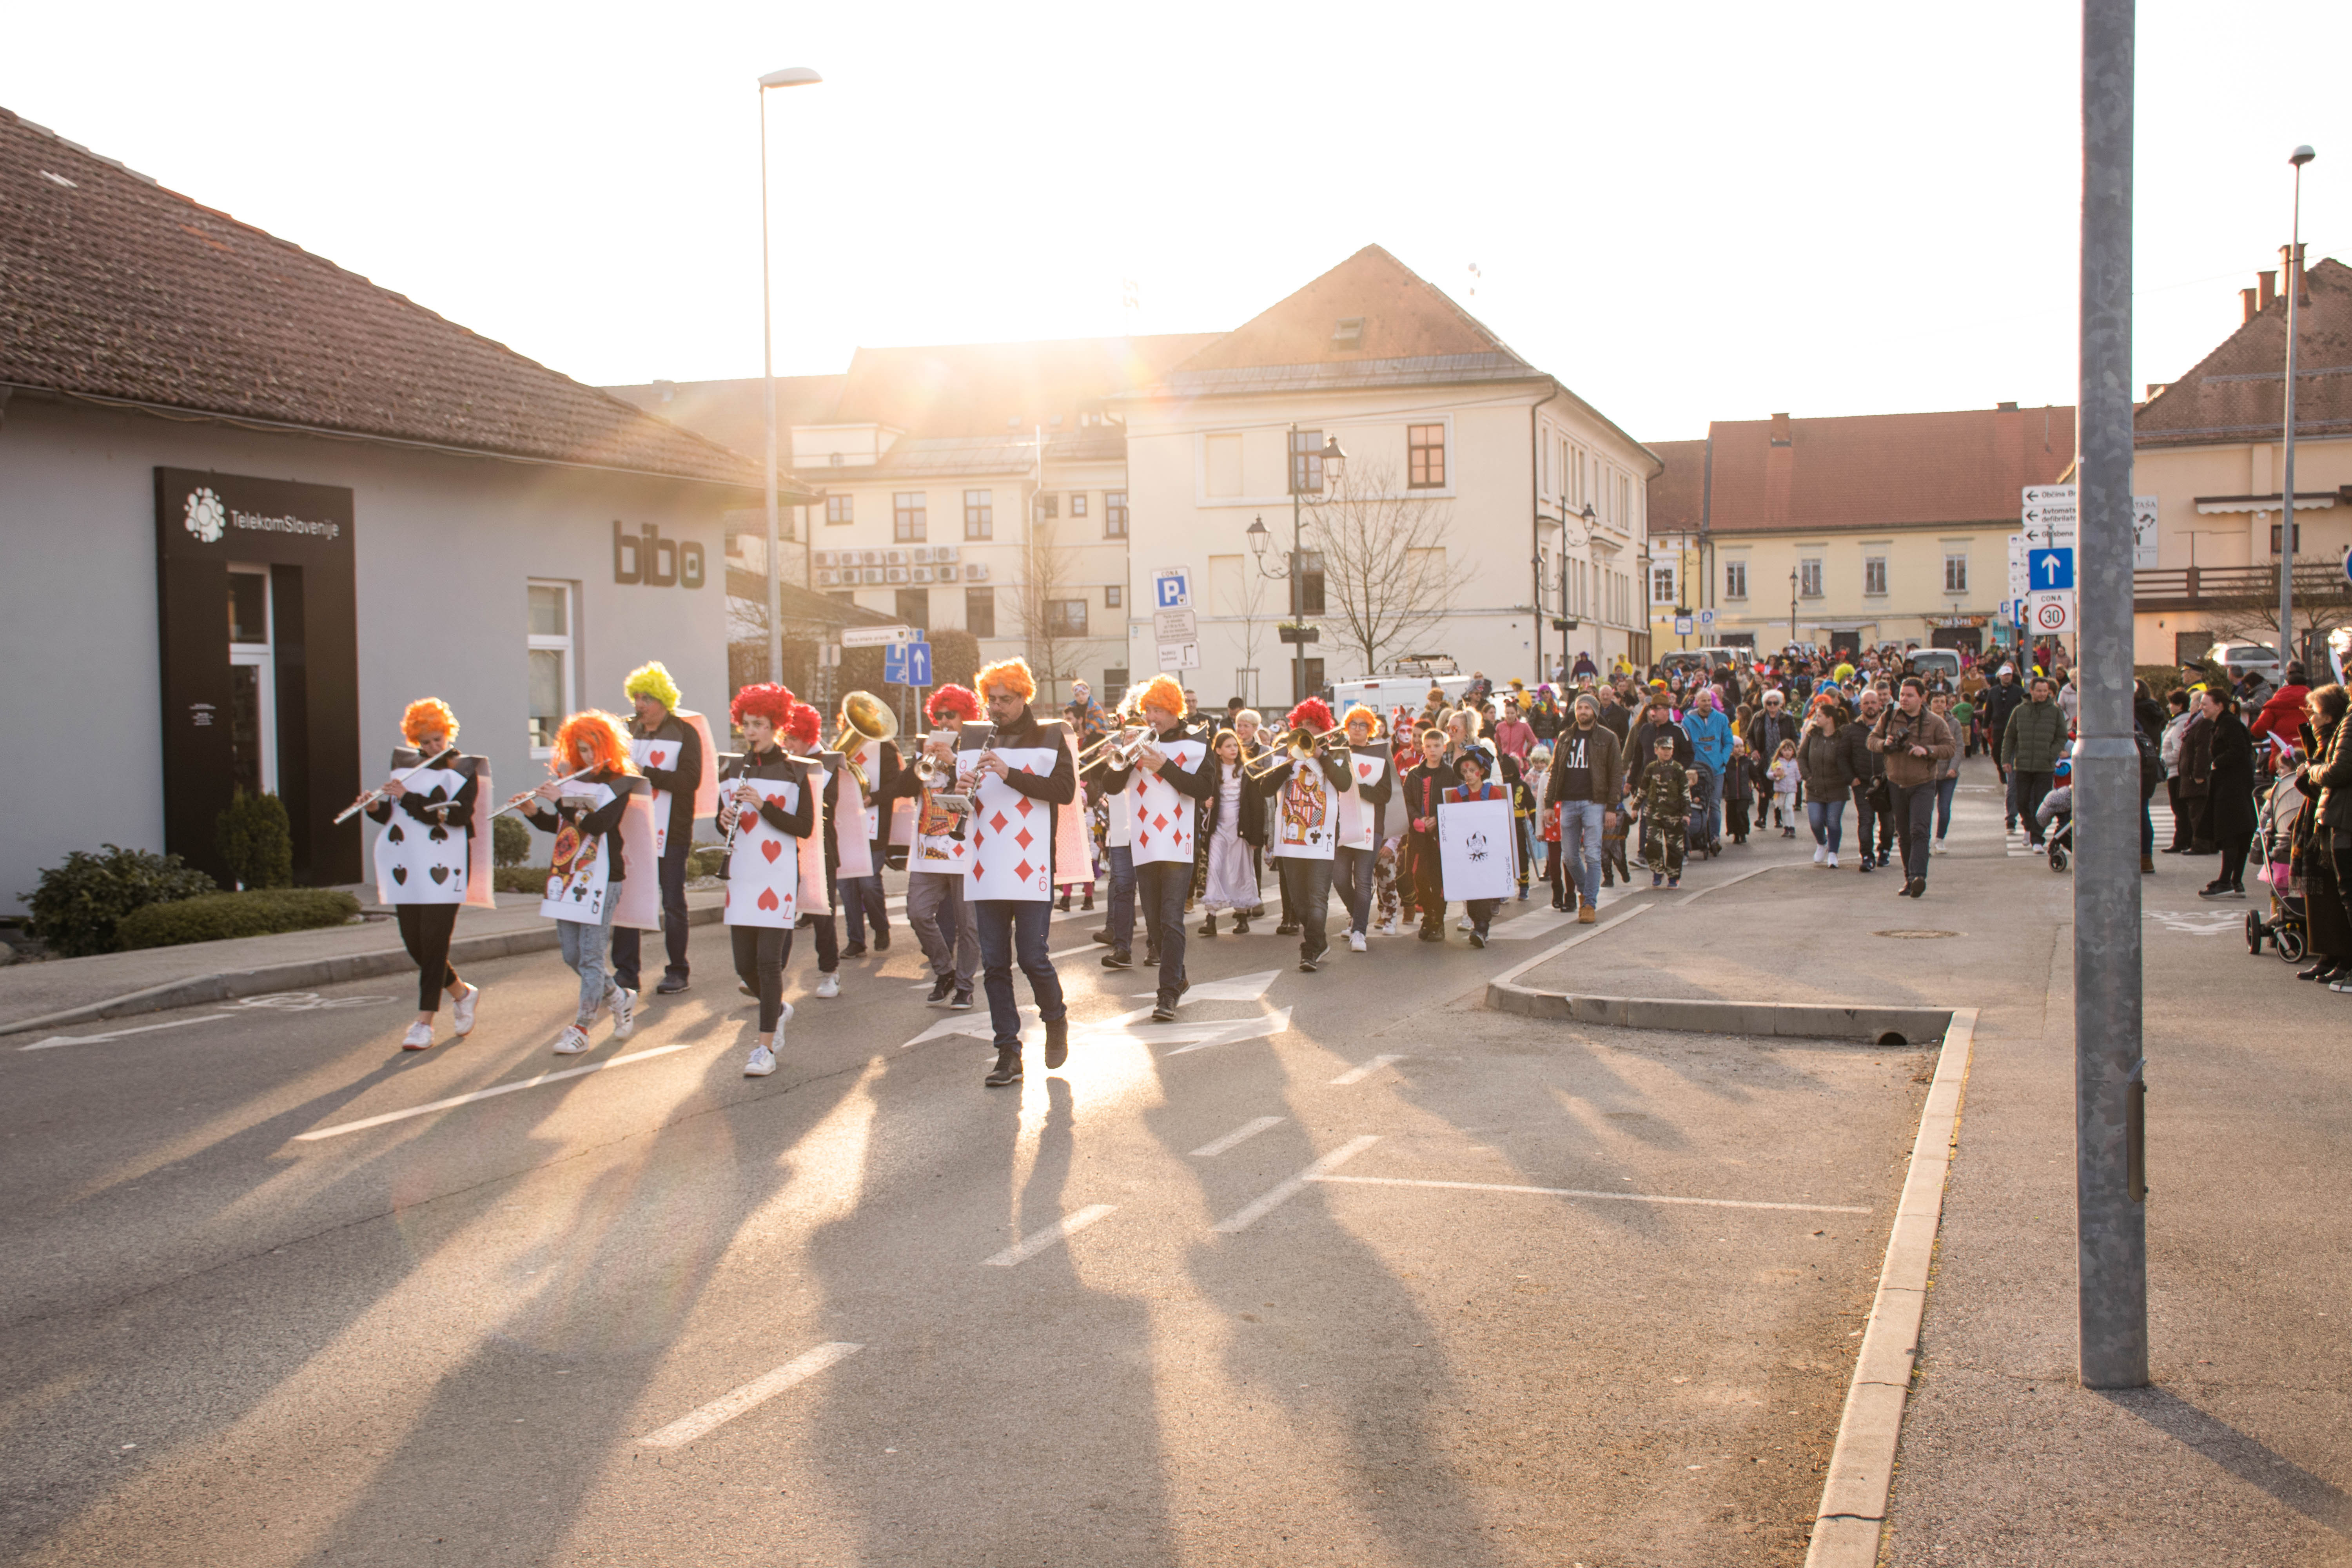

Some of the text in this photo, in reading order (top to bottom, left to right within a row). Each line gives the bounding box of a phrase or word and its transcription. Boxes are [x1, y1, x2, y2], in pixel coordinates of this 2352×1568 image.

[230, 509, 339, 540] TelekomSlovenije
[613, 520, 705, 589] bibo
[2044, 610, 2060, 623] 30
[959, 760, 967, 774] 9
